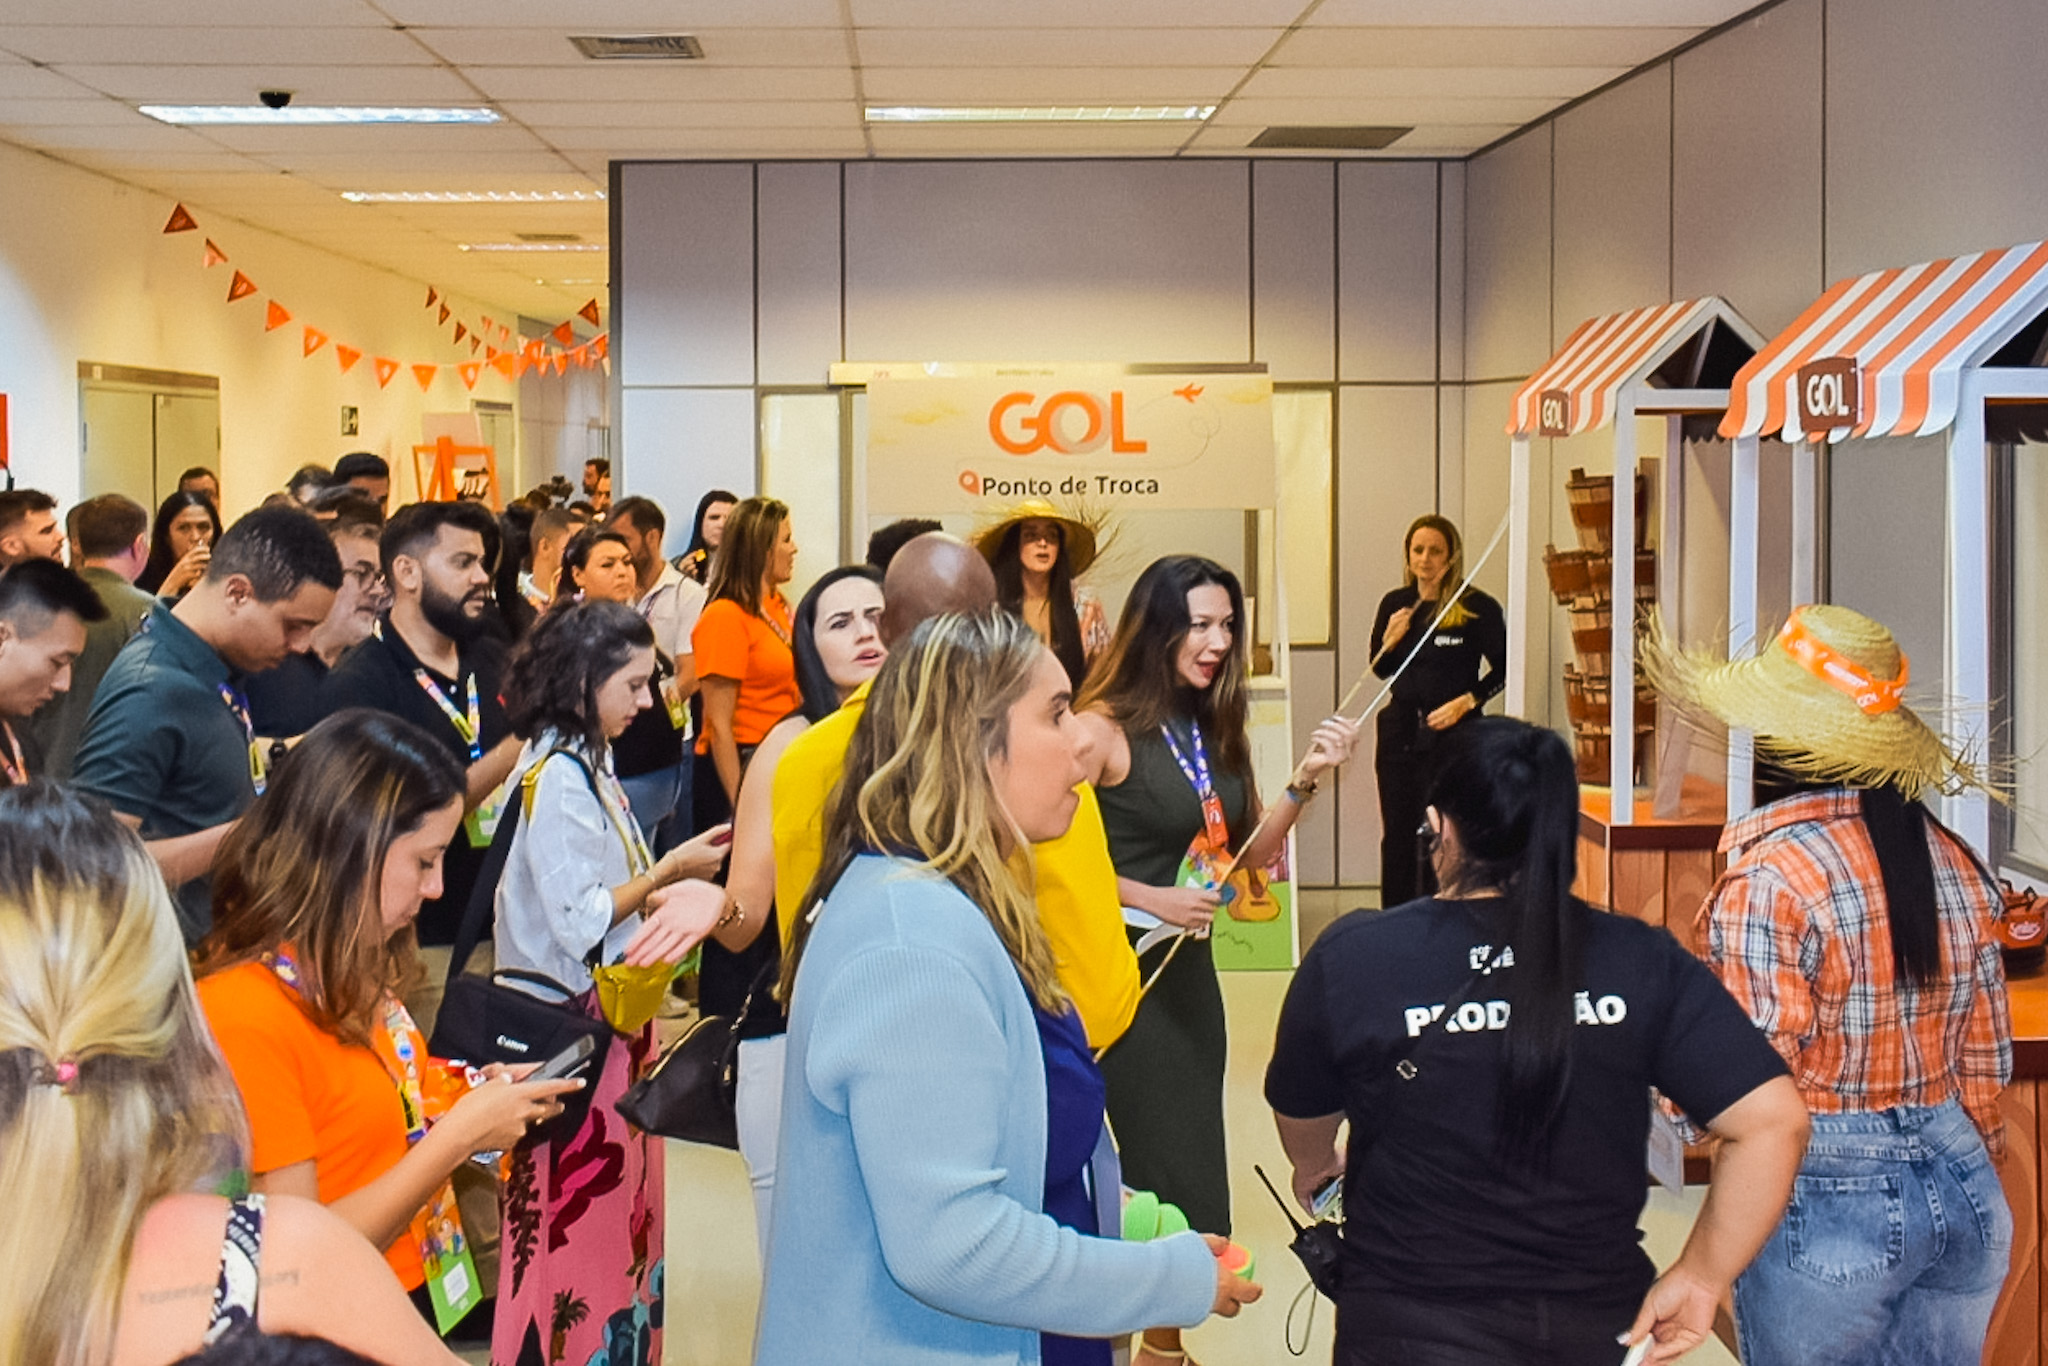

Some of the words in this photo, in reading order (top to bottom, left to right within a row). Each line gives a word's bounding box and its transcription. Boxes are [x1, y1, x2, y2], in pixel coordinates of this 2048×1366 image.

[1542, 398, 1565, 430] GOL
[1806, 373, 1850, 417] GOL
[989, 391, 1148, 456] GOL
[983, 477, 1052, 496] Ponto
[1060, 475, 1087, 495] de
[1095, 476, 1159, 495] Troca
